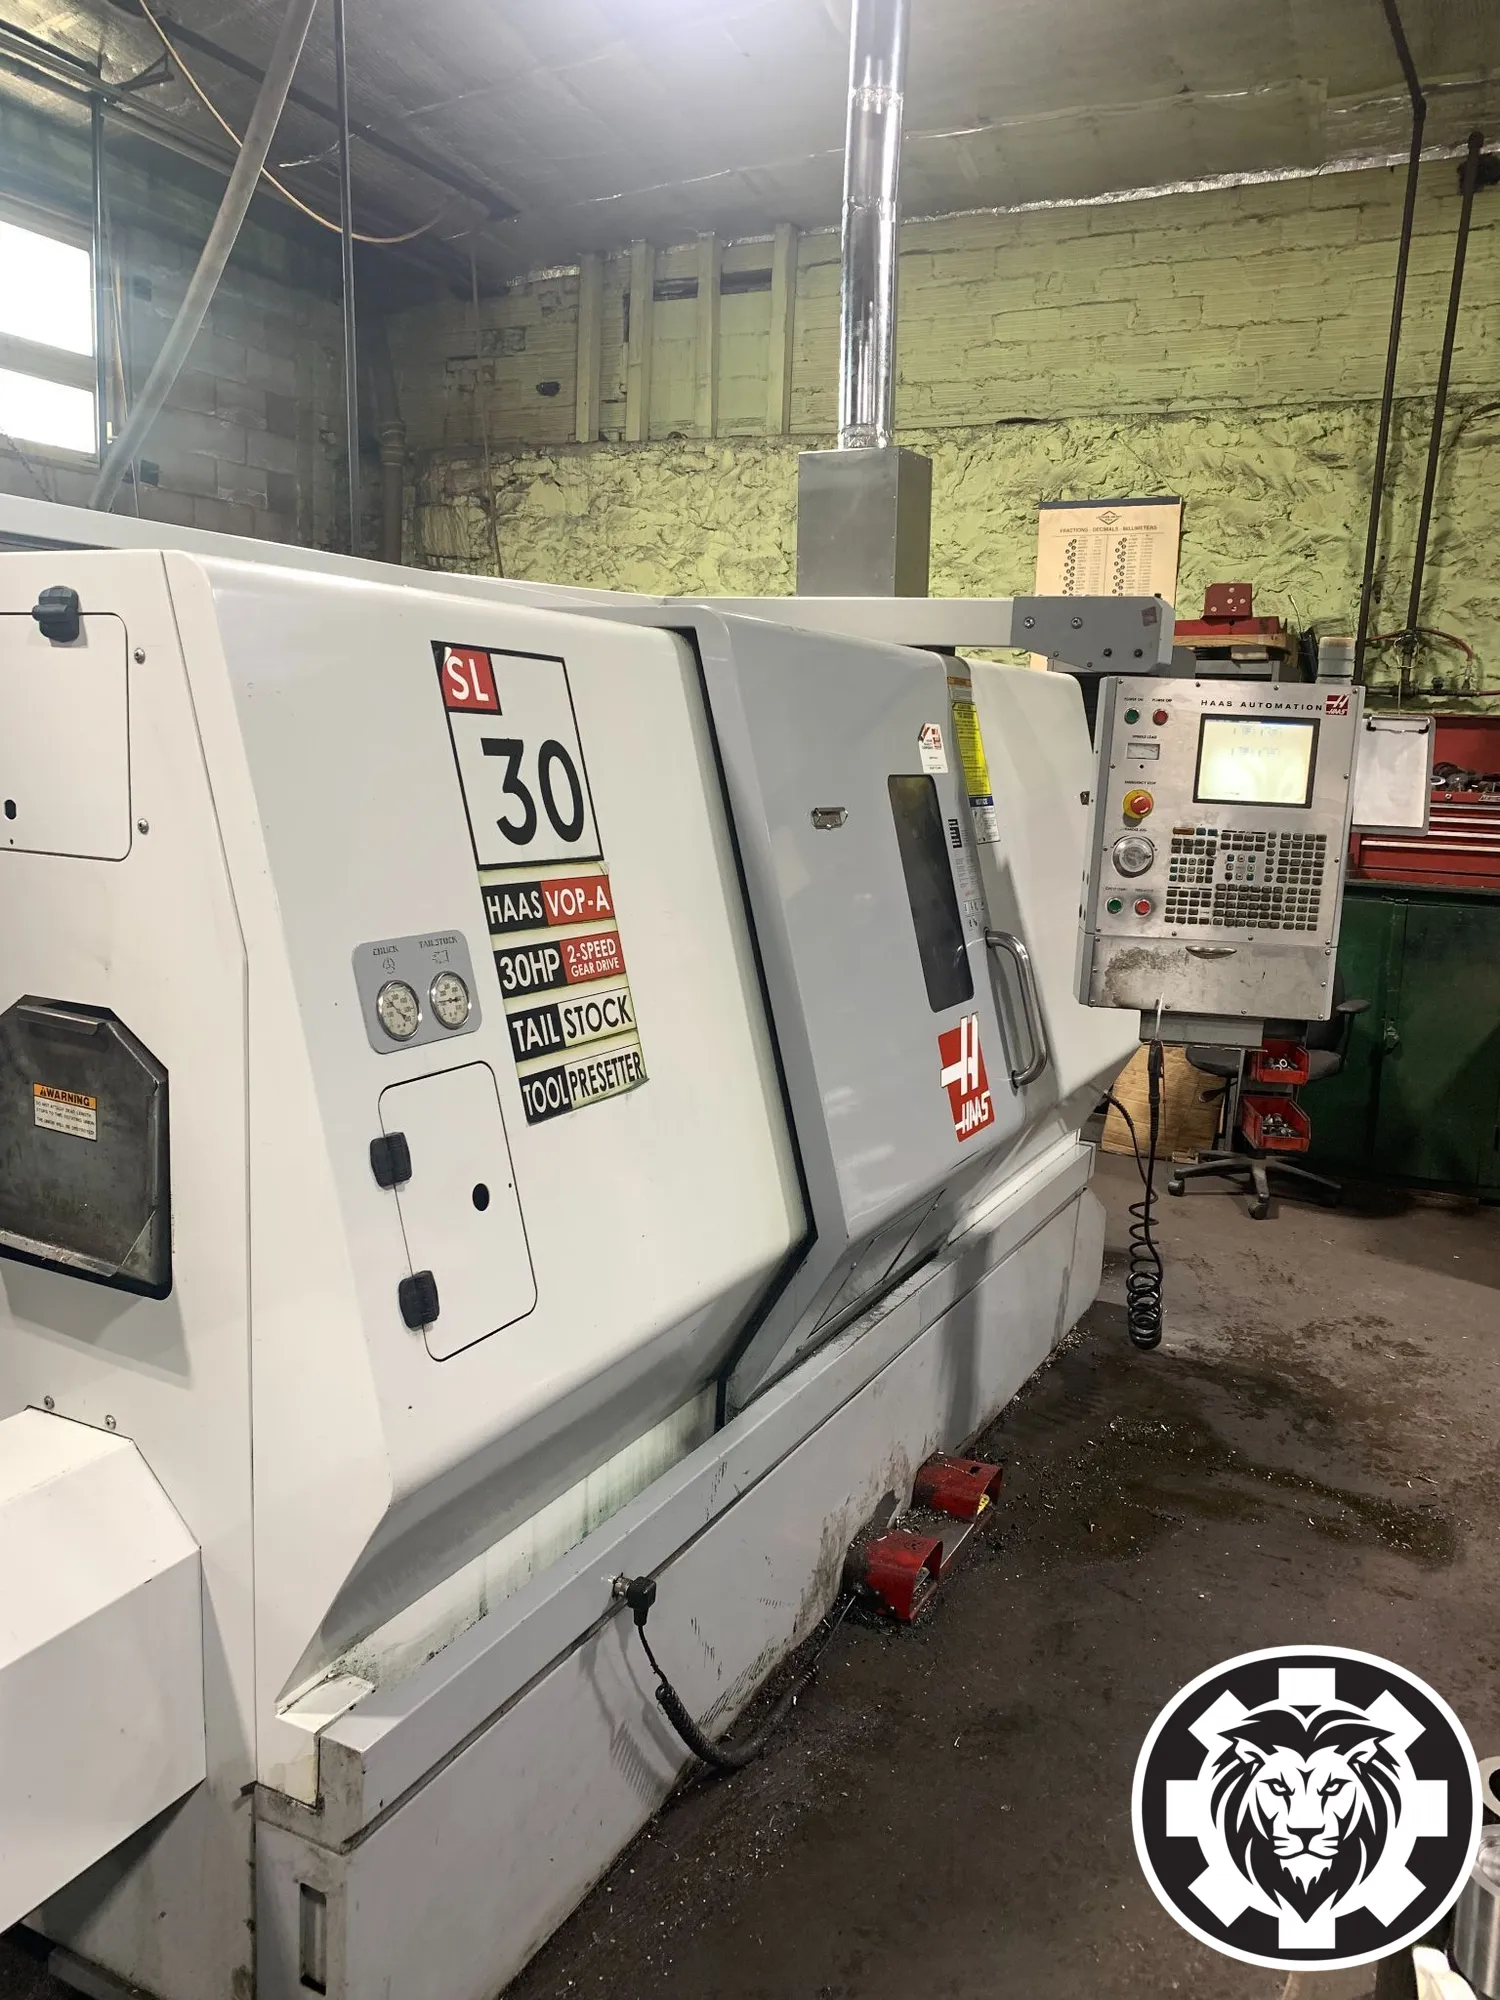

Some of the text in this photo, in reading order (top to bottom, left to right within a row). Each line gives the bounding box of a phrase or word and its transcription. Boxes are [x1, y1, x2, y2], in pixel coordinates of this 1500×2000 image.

[446, 655, 490, 702] SL
[1200, 699, 1323, 711] HAAS AUTOMATION
[480, 737, 585, 846] 30
[486, 885, 611, 925] HAAS VOP-A
[372, 945, 399, 956] CHUCK
[418, 936, 458, 949] TAILSTOCK
[500, 938, 616, 990] 30HP 2-SPEED
[571, 959, 619, 977] GEAR DRIVE
[512, 994, 632, 1052] TAIL STOCK
[46, 1088, 90, 1107] WARNING
[523, 1051, 644, 1116] TOOL PRESETTER
[955, 1090, 991, 1134] HAAS
